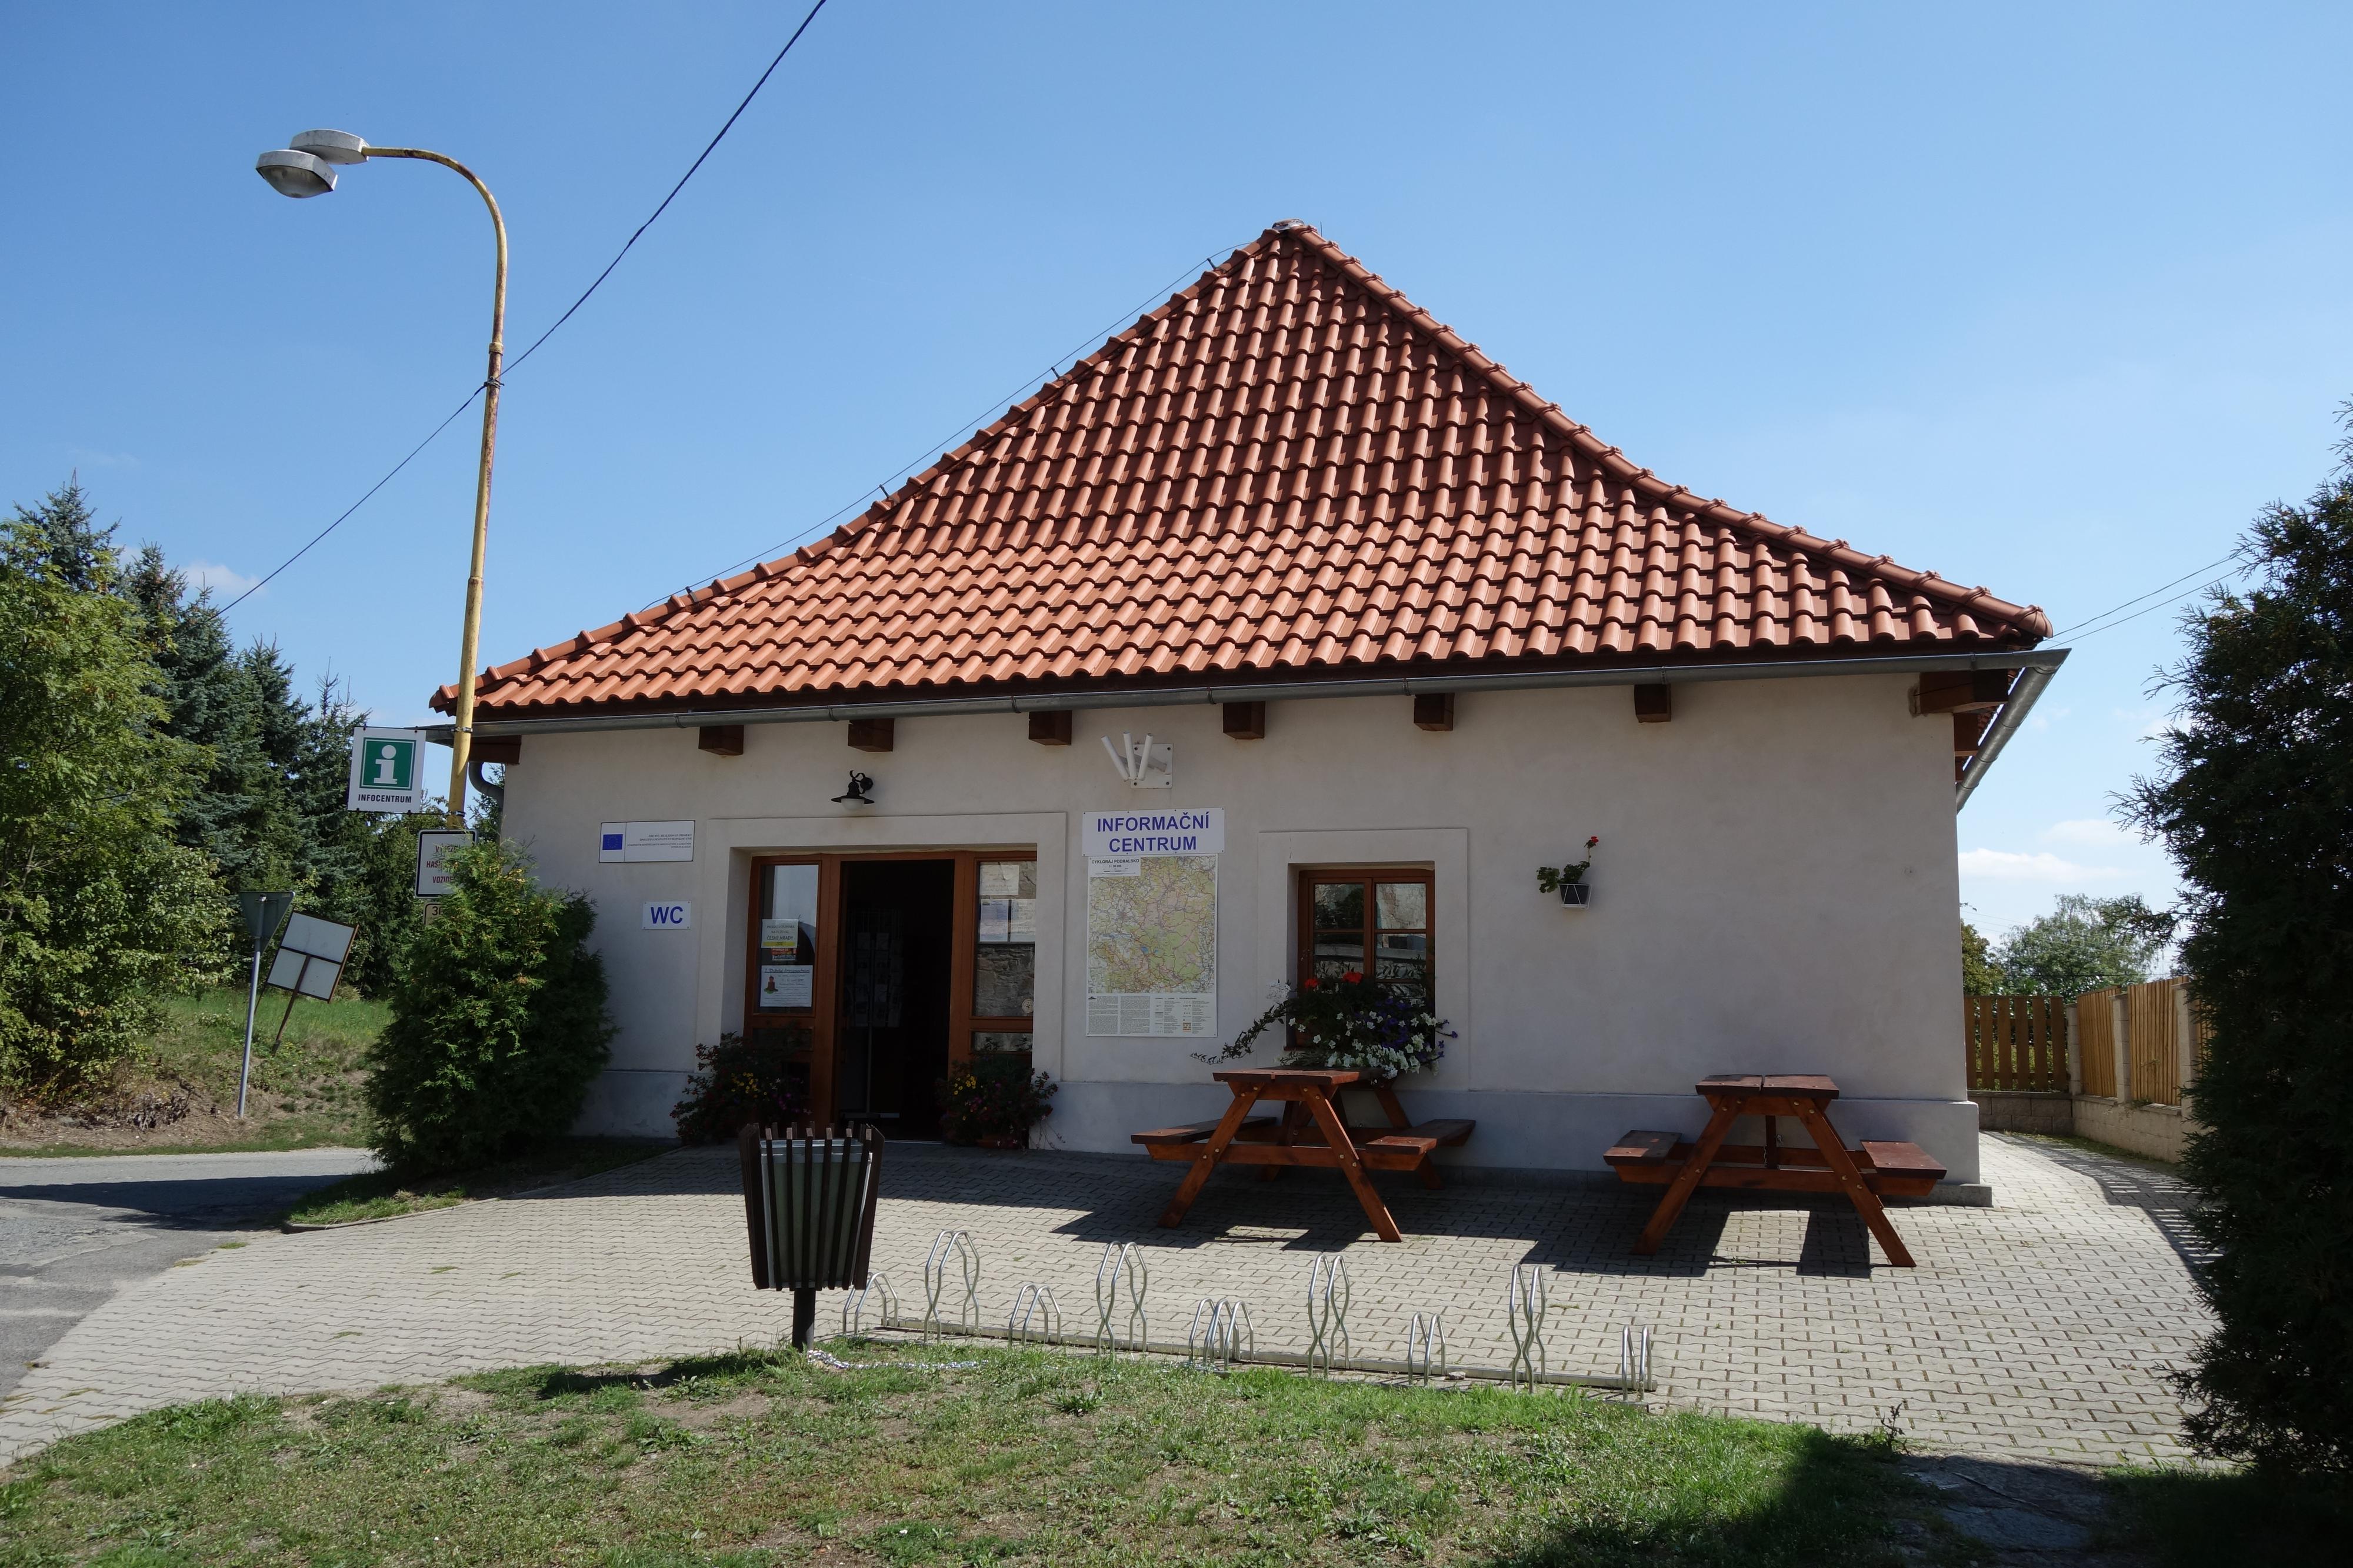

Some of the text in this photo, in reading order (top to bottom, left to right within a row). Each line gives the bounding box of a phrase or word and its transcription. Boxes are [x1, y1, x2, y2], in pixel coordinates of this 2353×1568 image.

[358, 793, 412, 803] INFOCENTRUM
[1097, 812, 1210, 832] INFORMAČNÍ
[1109, 836, 1197, 853] CENTRUM
[651, 906, 683, 924] WC
